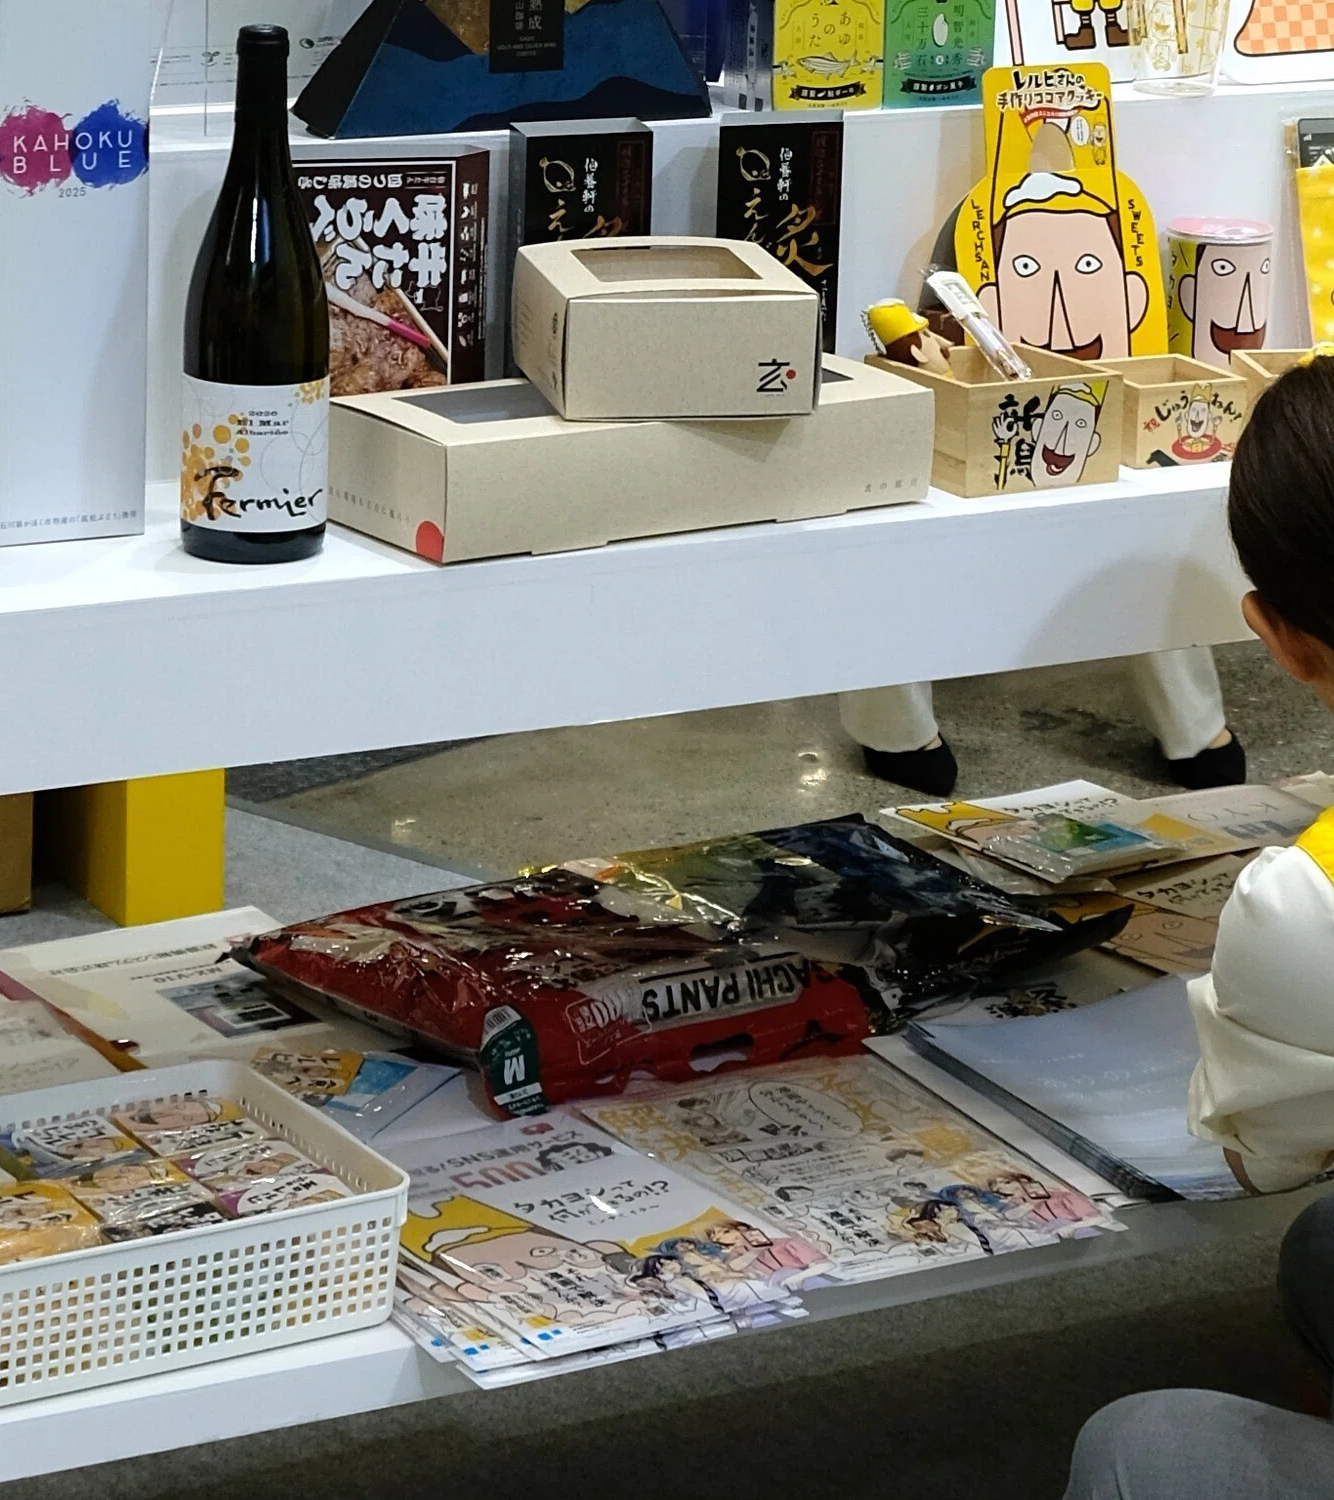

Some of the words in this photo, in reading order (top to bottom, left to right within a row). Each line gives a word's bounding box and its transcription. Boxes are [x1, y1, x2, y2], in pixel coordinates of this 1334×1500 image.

[1012, 69, 1085, 90] レルヒさんの
[996, 89, 1103, 111] 手作りココアクッキー
[12, 129, 134, 153] KAHOKU
[12, 151, 133, 175] BLUE
[57, 185, 88, 199] 2025
[970, 198, 991, 282] LERCHSAN
[1127, 198, 1145, 268] SWEETS
[335, 242, 448, 290] 牛たん
[194, 465, 323, 522] Fermier
[642, 972, 741, 1020] PANTS
